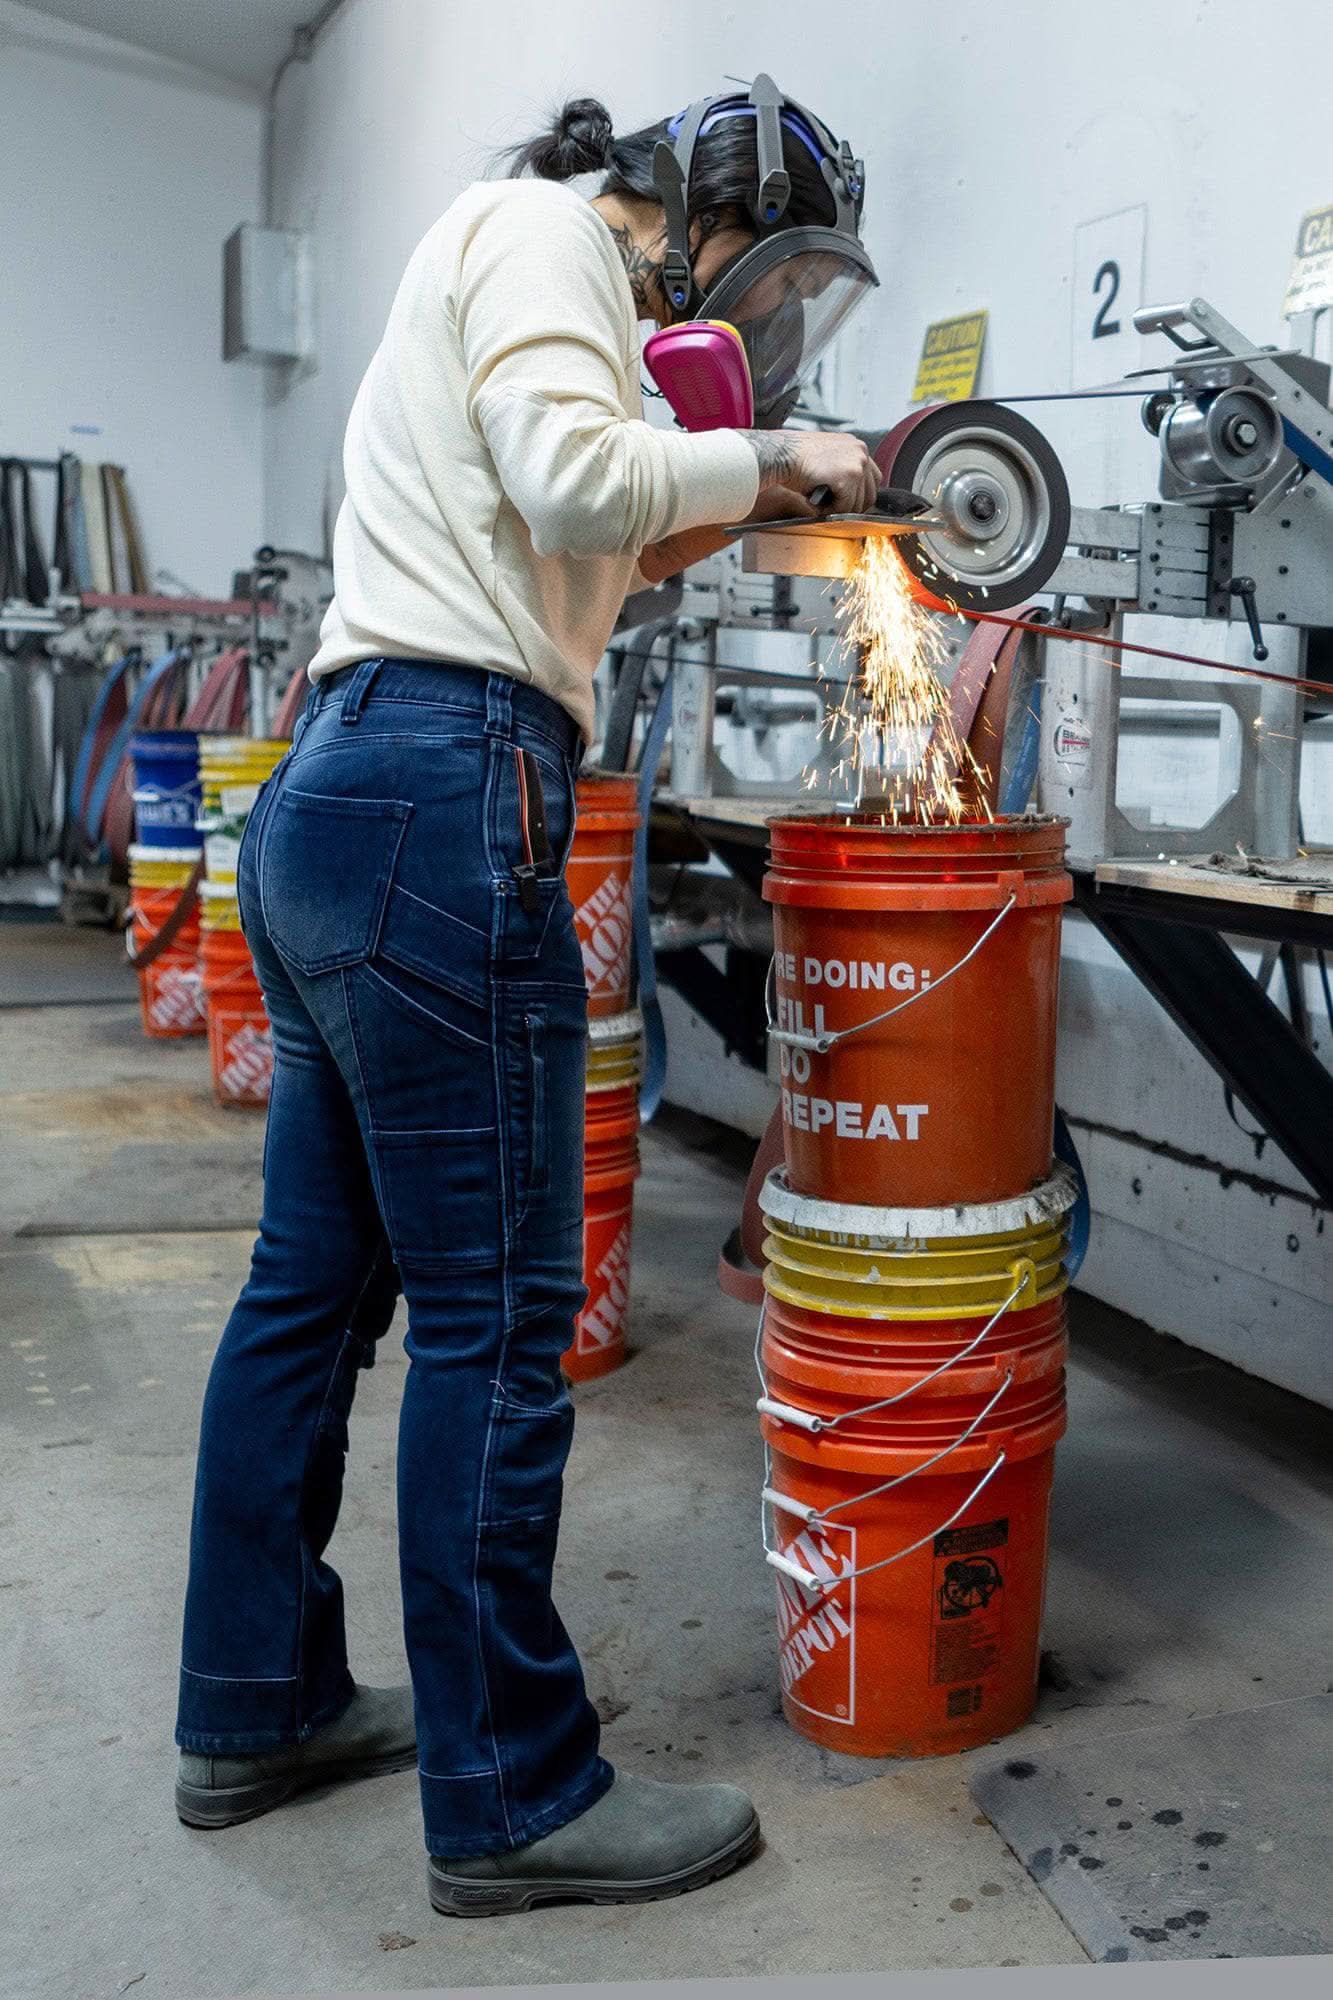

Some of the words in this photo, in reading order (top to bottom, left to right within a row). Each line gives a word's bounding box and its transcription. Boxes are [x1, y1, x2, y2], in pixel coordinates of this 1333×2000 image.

[1092, 261, 1120, 339] 2
[926, 321, 979, 355] CAUTION
[804, 957, 931, 991] DOING:
[781, 1044, 811, 1084] DO
[782, 1088, 929, 1141] REPEAT
[781, 1598, 850, 1692] DEPOT
